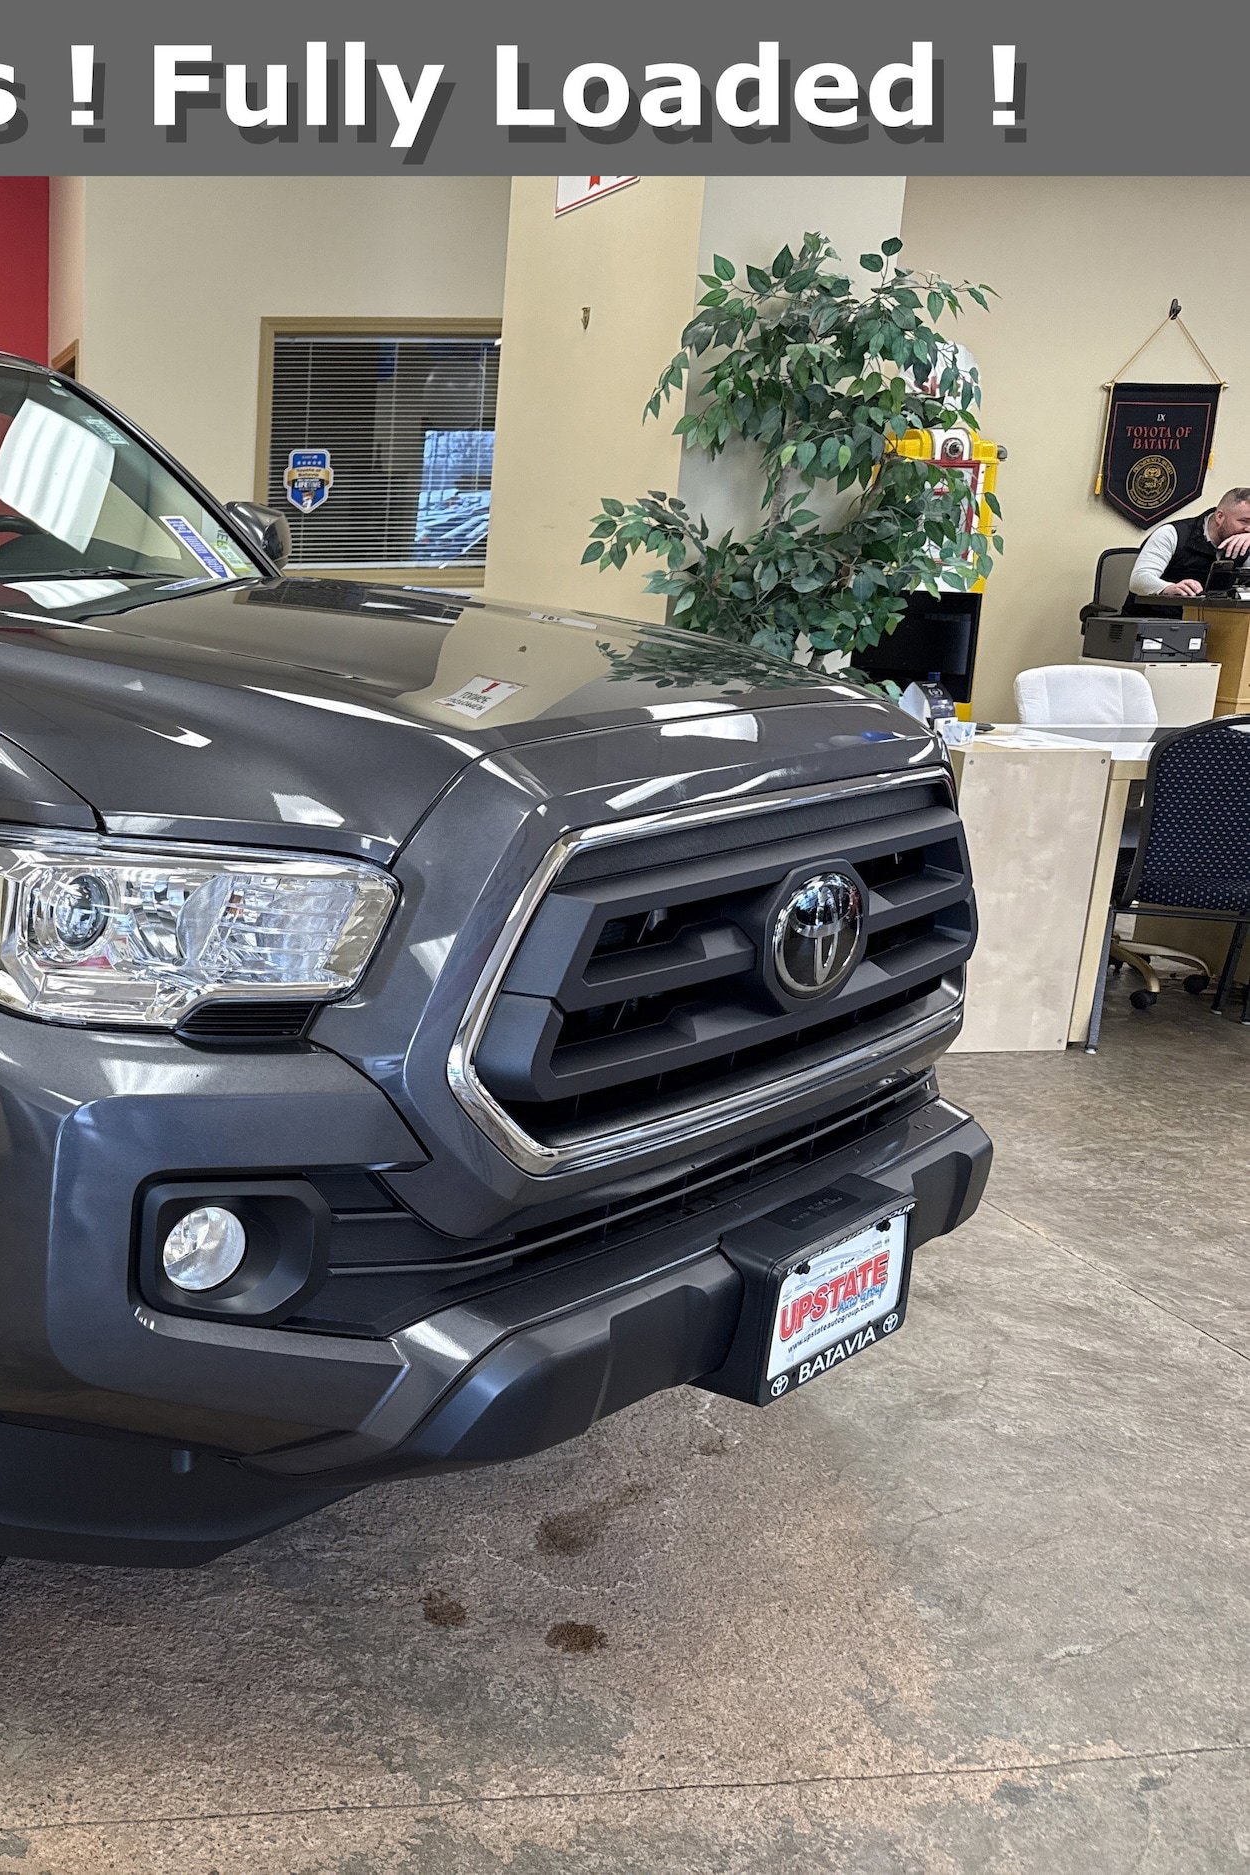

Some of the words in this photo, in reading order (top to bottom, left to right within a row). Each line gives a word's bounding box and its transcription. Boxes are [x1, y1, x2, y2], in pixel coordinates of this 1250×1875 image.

[1126, 426, 1171, 438] TOYOTA
[1176, 427, 1192, 438] OF
[1133, 438, 1181, 450] BATAVIA
[779, 1250, 890, 1342] UPSTATE
[787, 1300, 875, 1354] www.upstateautogroup.com
[798, 1325, 877, 1385] BATAVIA
